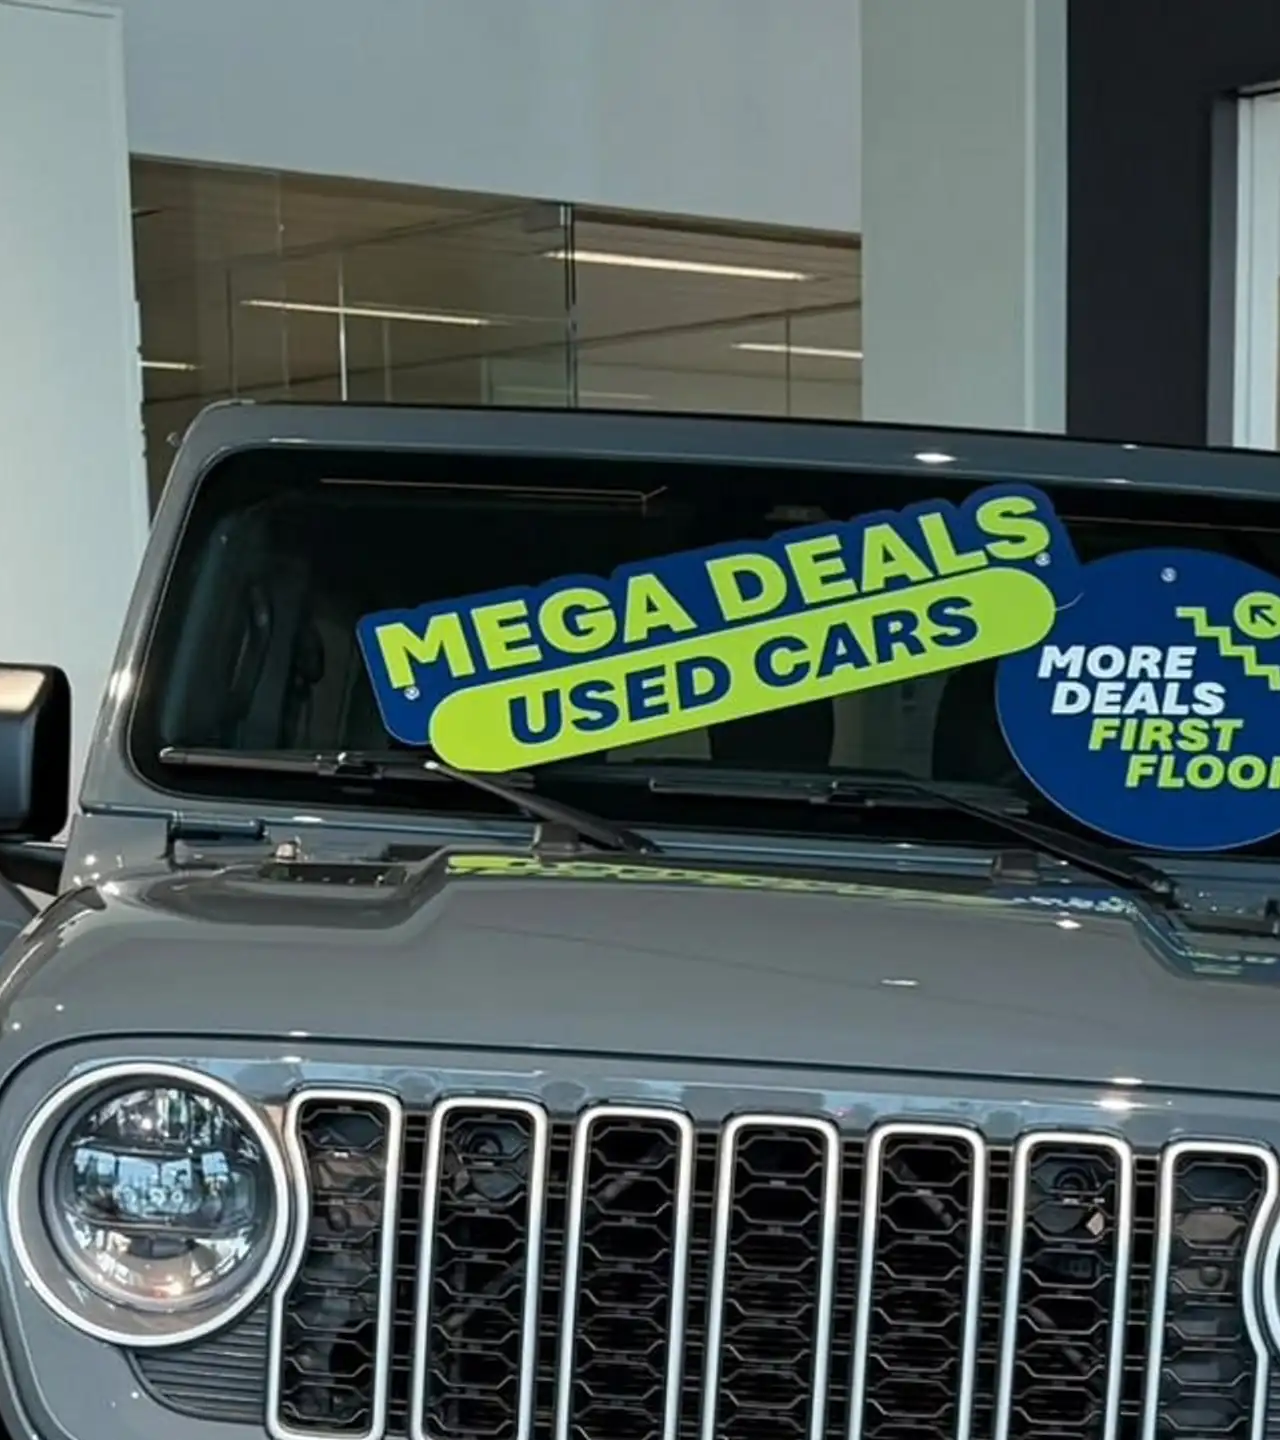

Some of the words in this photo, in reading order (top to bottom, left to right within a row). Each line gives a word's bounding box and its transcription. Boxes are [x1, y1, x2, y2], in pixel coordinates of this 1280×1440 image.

[374, 572, 698, 690] MEGA
[705, 496, 1051, 622] DEALS
[508, 655, 732, 745] USED
[754, 596, 979, 688] CARS
[1037, 645, 1197, 679] MORE
[1051, 681, 1227, 716] DEALS
[1088, 718, 1245, 751] FIRST
